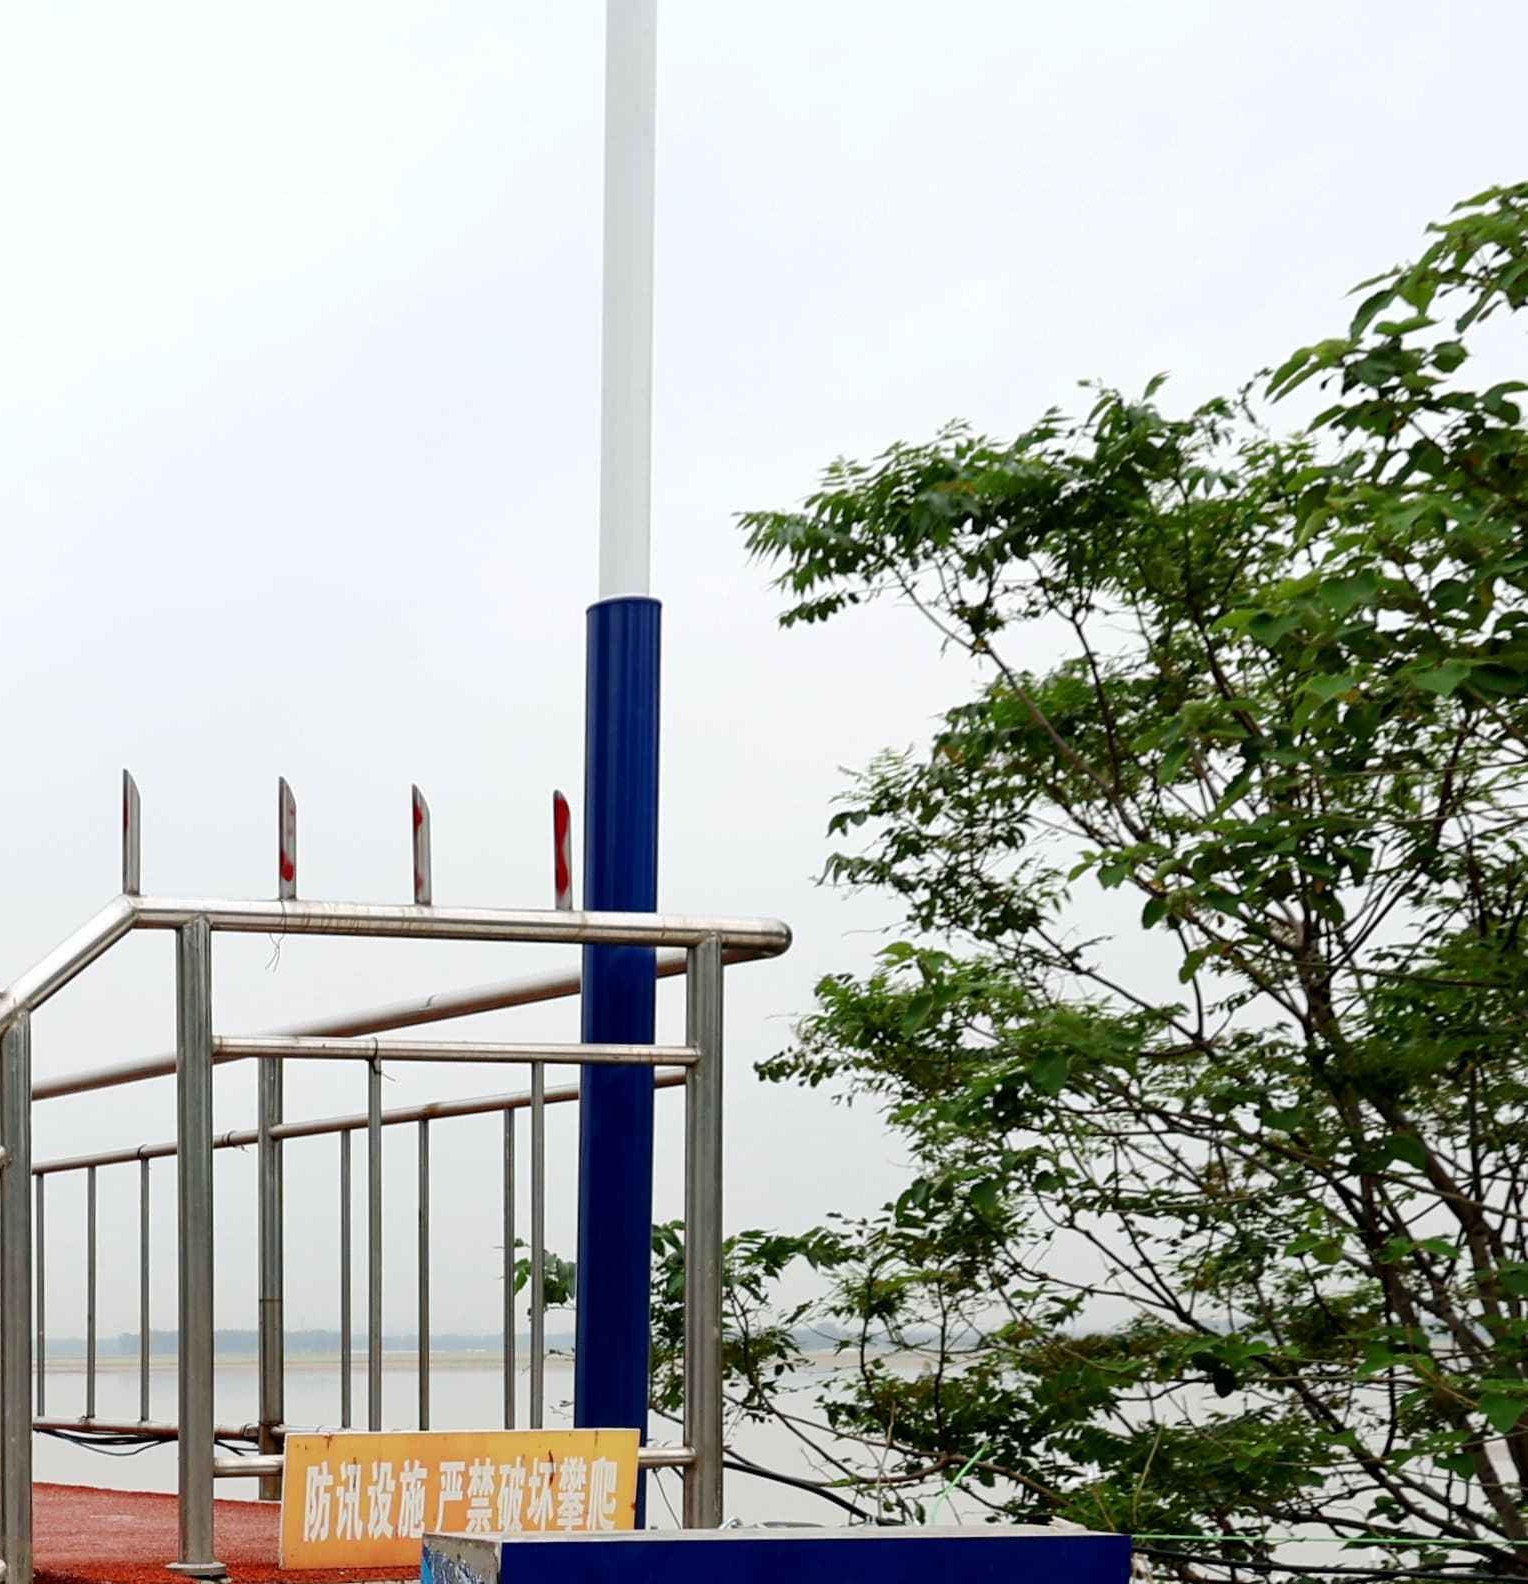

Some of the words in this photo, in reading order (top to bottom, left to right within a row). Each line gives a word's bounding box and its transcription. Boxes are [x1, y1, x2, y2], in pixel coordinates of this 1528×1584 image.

[434, 1455, 619, 1533] 严禁破坏攀爬
